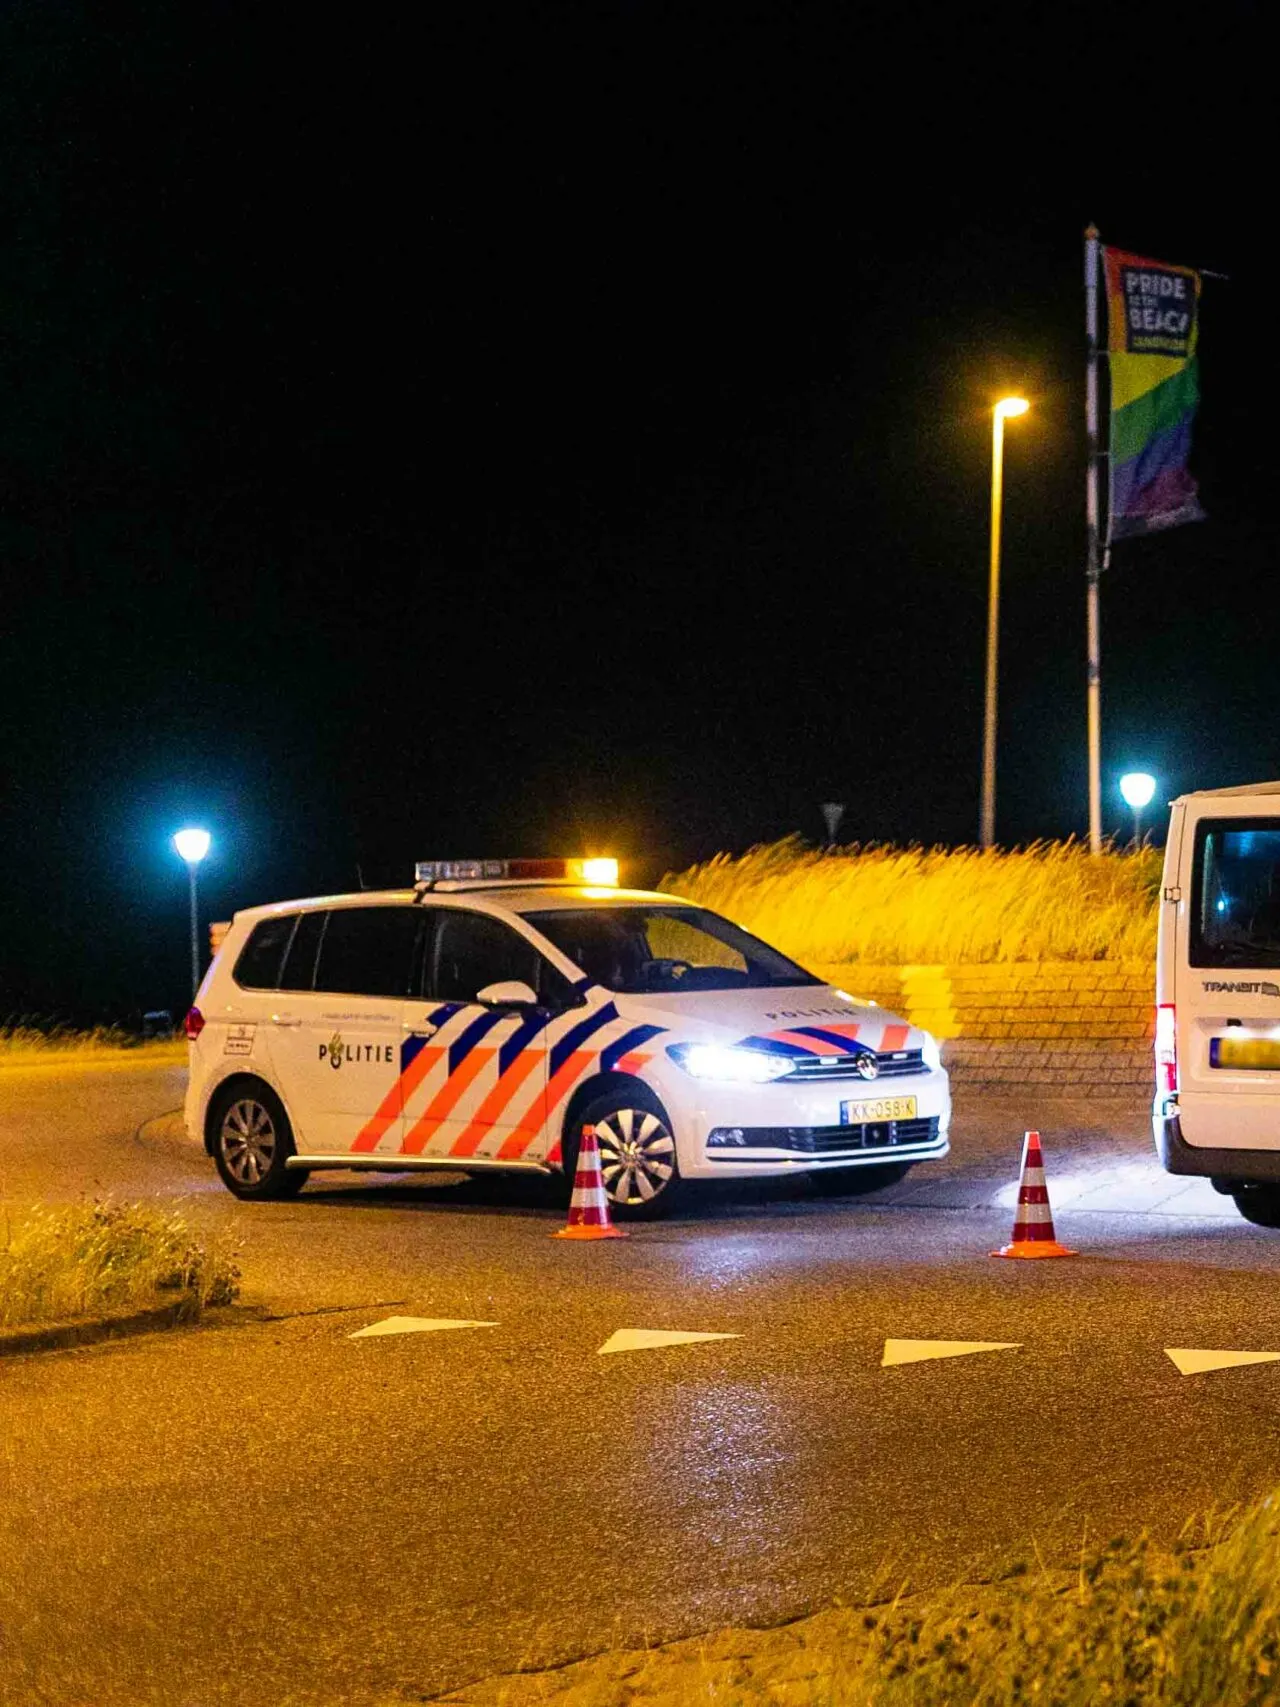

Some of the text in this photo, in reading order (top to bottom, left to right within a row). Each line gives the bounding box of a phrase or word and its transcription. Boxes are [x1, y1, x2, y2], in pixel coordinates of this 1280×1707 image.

[1125, 272, 1186, 299] PRIDE
[1202, 981, 1261, 993] TRANSIT
[765, 1008, 858, 1020] POLITIE
